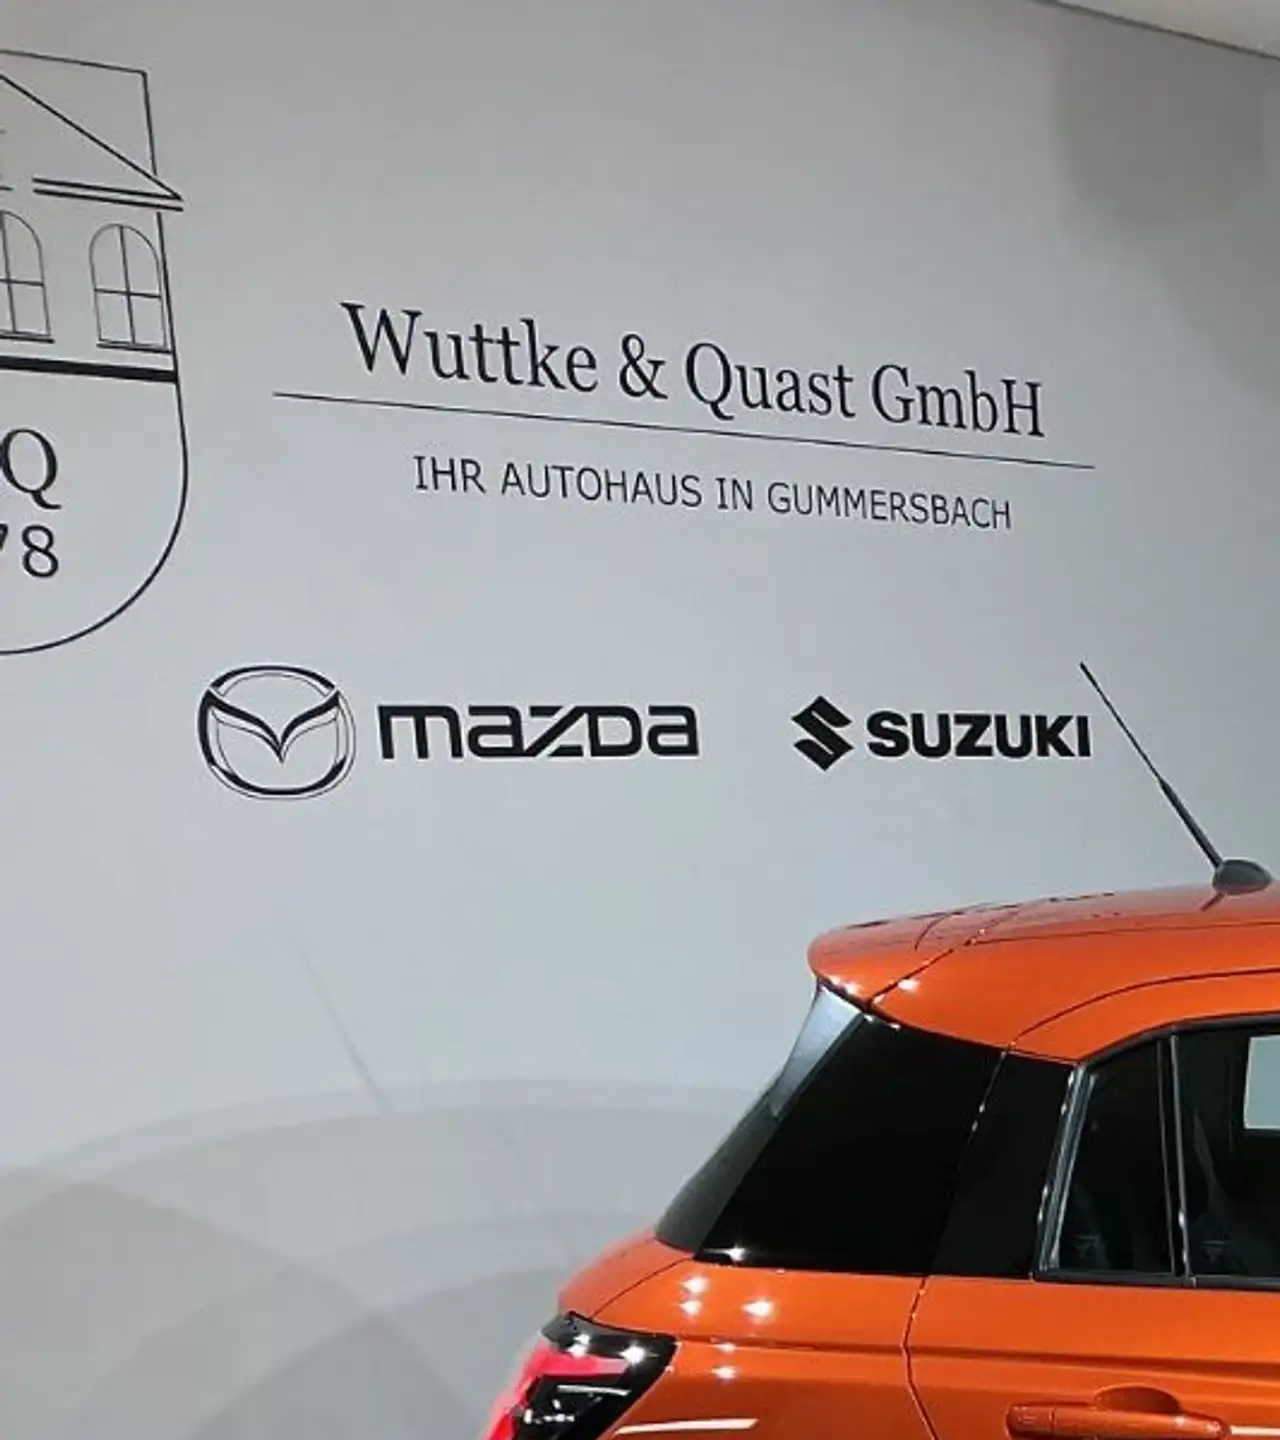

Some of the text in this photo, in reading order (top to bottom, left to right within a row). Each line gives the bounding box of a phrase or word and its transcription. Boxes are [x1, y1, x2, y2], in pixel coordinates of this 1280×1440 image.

[339, 301, 1045, 438] Wuttke & Quast GmbH
[412, 455, 1011, 530] IHR AUTOHAUS IN GUMMERSBACH
[0, 523, 60, 579] 8
[866, 710, 1092, 759] SUZUKI
